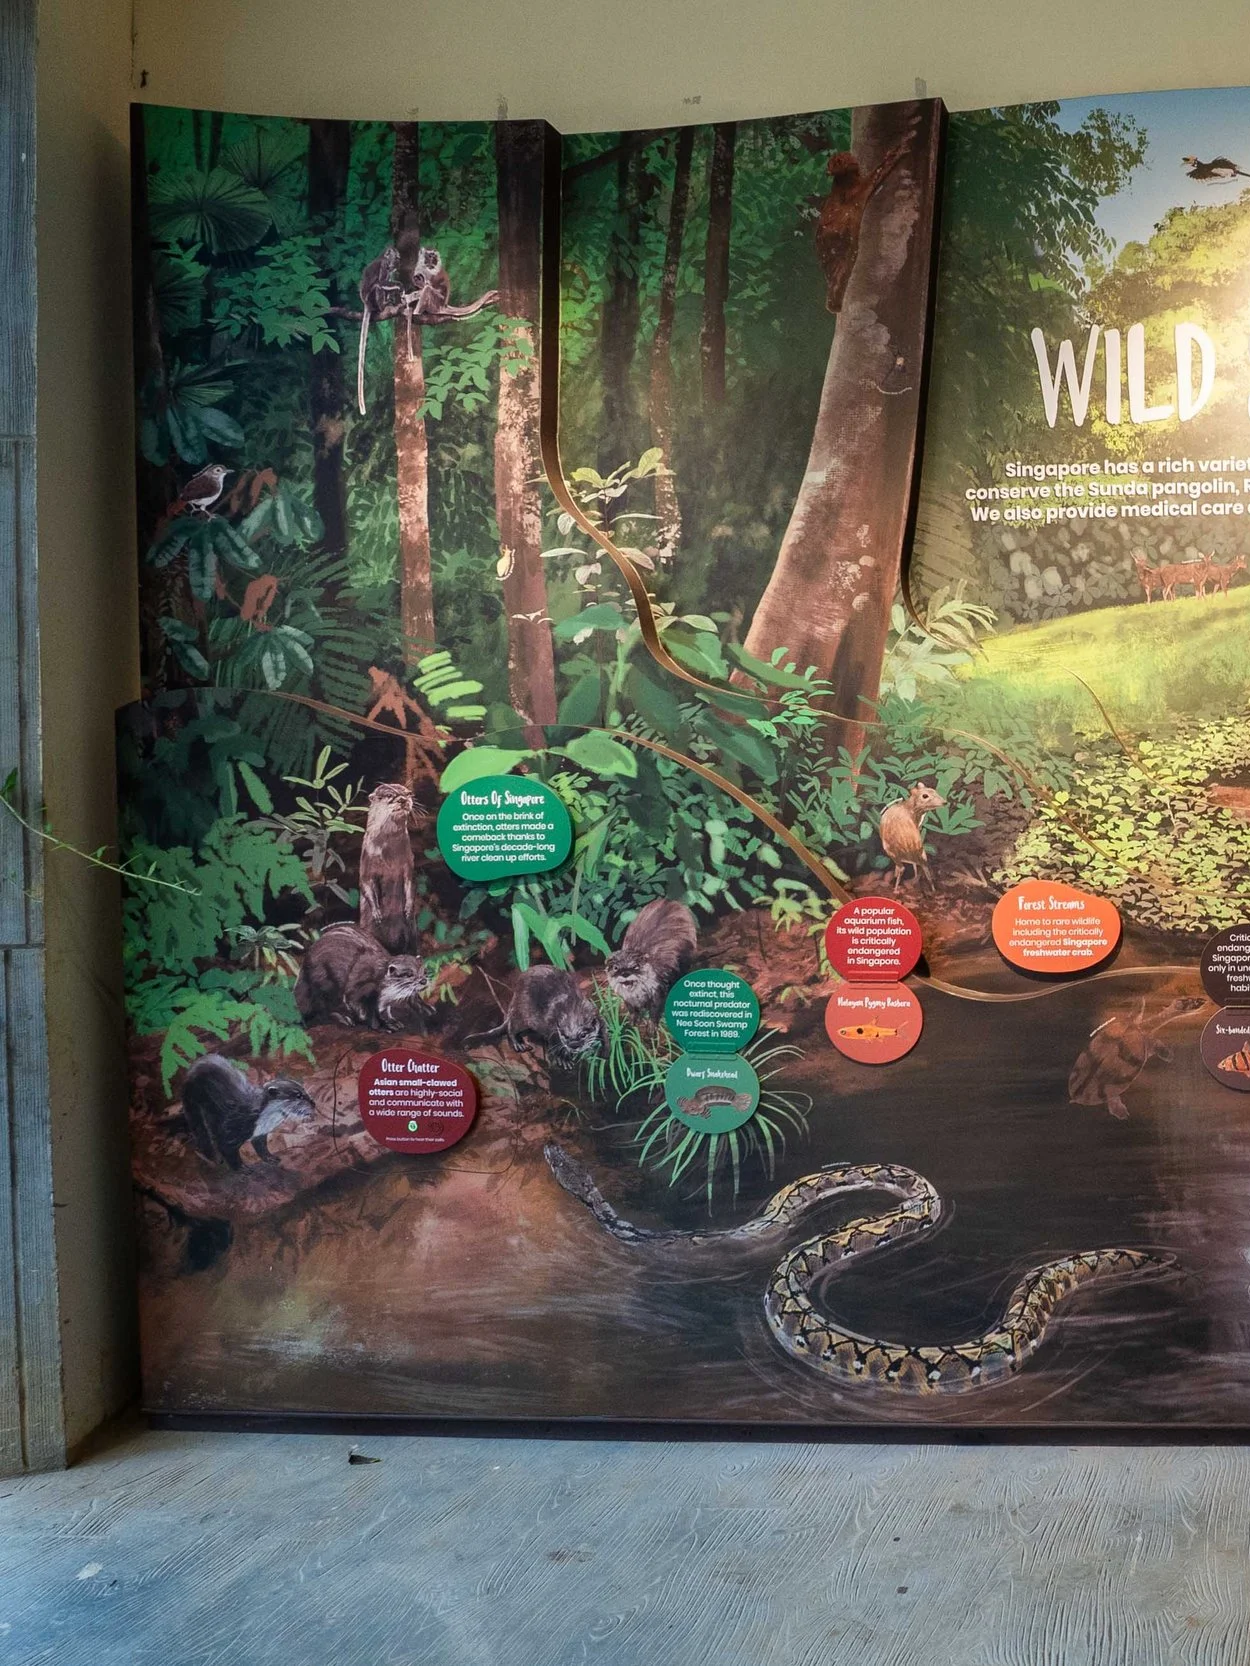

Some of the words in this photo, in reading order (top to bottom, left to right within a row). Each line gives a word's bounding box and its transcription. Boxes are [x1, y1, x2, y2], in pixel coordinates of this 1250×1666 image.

[1031, 324, 1215, 427] WILD
[1006, 462, 1100, 480] Singapore
[1104, 460, 1139, 474] has
[1142, 462, 1154, 473] a
[1158, 458, 1195, 472] rich
[966, 487, 1050, 499] conserve
[1054, 483, 1085, 496] the
[1089, 481, 1148, 496] Sunda
[1152, 479, 1240, 498] pangolin,
[971, 507, 1000, 521] We
[1004, 506, 1042, 520] also
[1047, 503, 1118, 523] provide
[1121, 501, 1197, 516] medical
[1201, 503, 1244, 515] care
[461, 791, 489, 805] Otters
[491, 791, 502, 807] Of
[504, 791, 545, 807] Singapore
[513, 812, 534, 820] brink
[453, 823, 495, 831] extinction,
[452, 844, 500, 853] Singapore's
[500, 843, 555, 852] decade-long
[1018, 896, 1046, 910] Forest
[1049, 896, 1085, 910] Streams
[861, 908, 895, 916] popular
[844, 917, 886, 926] aquarium
[887, 917, 904, 925] fish,
[1071, 917, 1101, 925] wildlife
[866, 928, 912, 936] population
[860, 937, 896, 946] critically
[1009, 939, 1061, 948] endangered
[1063, 938, 1108, 947] Singapore
[847, 948, 900, 957] endangered
[856, 957, 901, 966] Singapore.
[1208, 964, 1227, 973] only
[684, 980, 706, 988] Once
[707, 981, 740, 990] thought
[714, 1001, 751, 1009] predator
[690, 1010, 744, 1018] rediscovered
[716, 1020, 748, 1030] Swamp
[1216, 1024, 1250, 1034] Six-banded
[684, 1029, 710, 1037] Forest
[720, 1030, 740, 1038] 1989.
[381, 1058, 405, 1072] Otter
[407, 1059, 440, 1073] Chatter
[374, 1078, 398, 1086] Asian
[410, 1089, 463, 1098] highly-social
[397, 1110, 422, 1118] range
